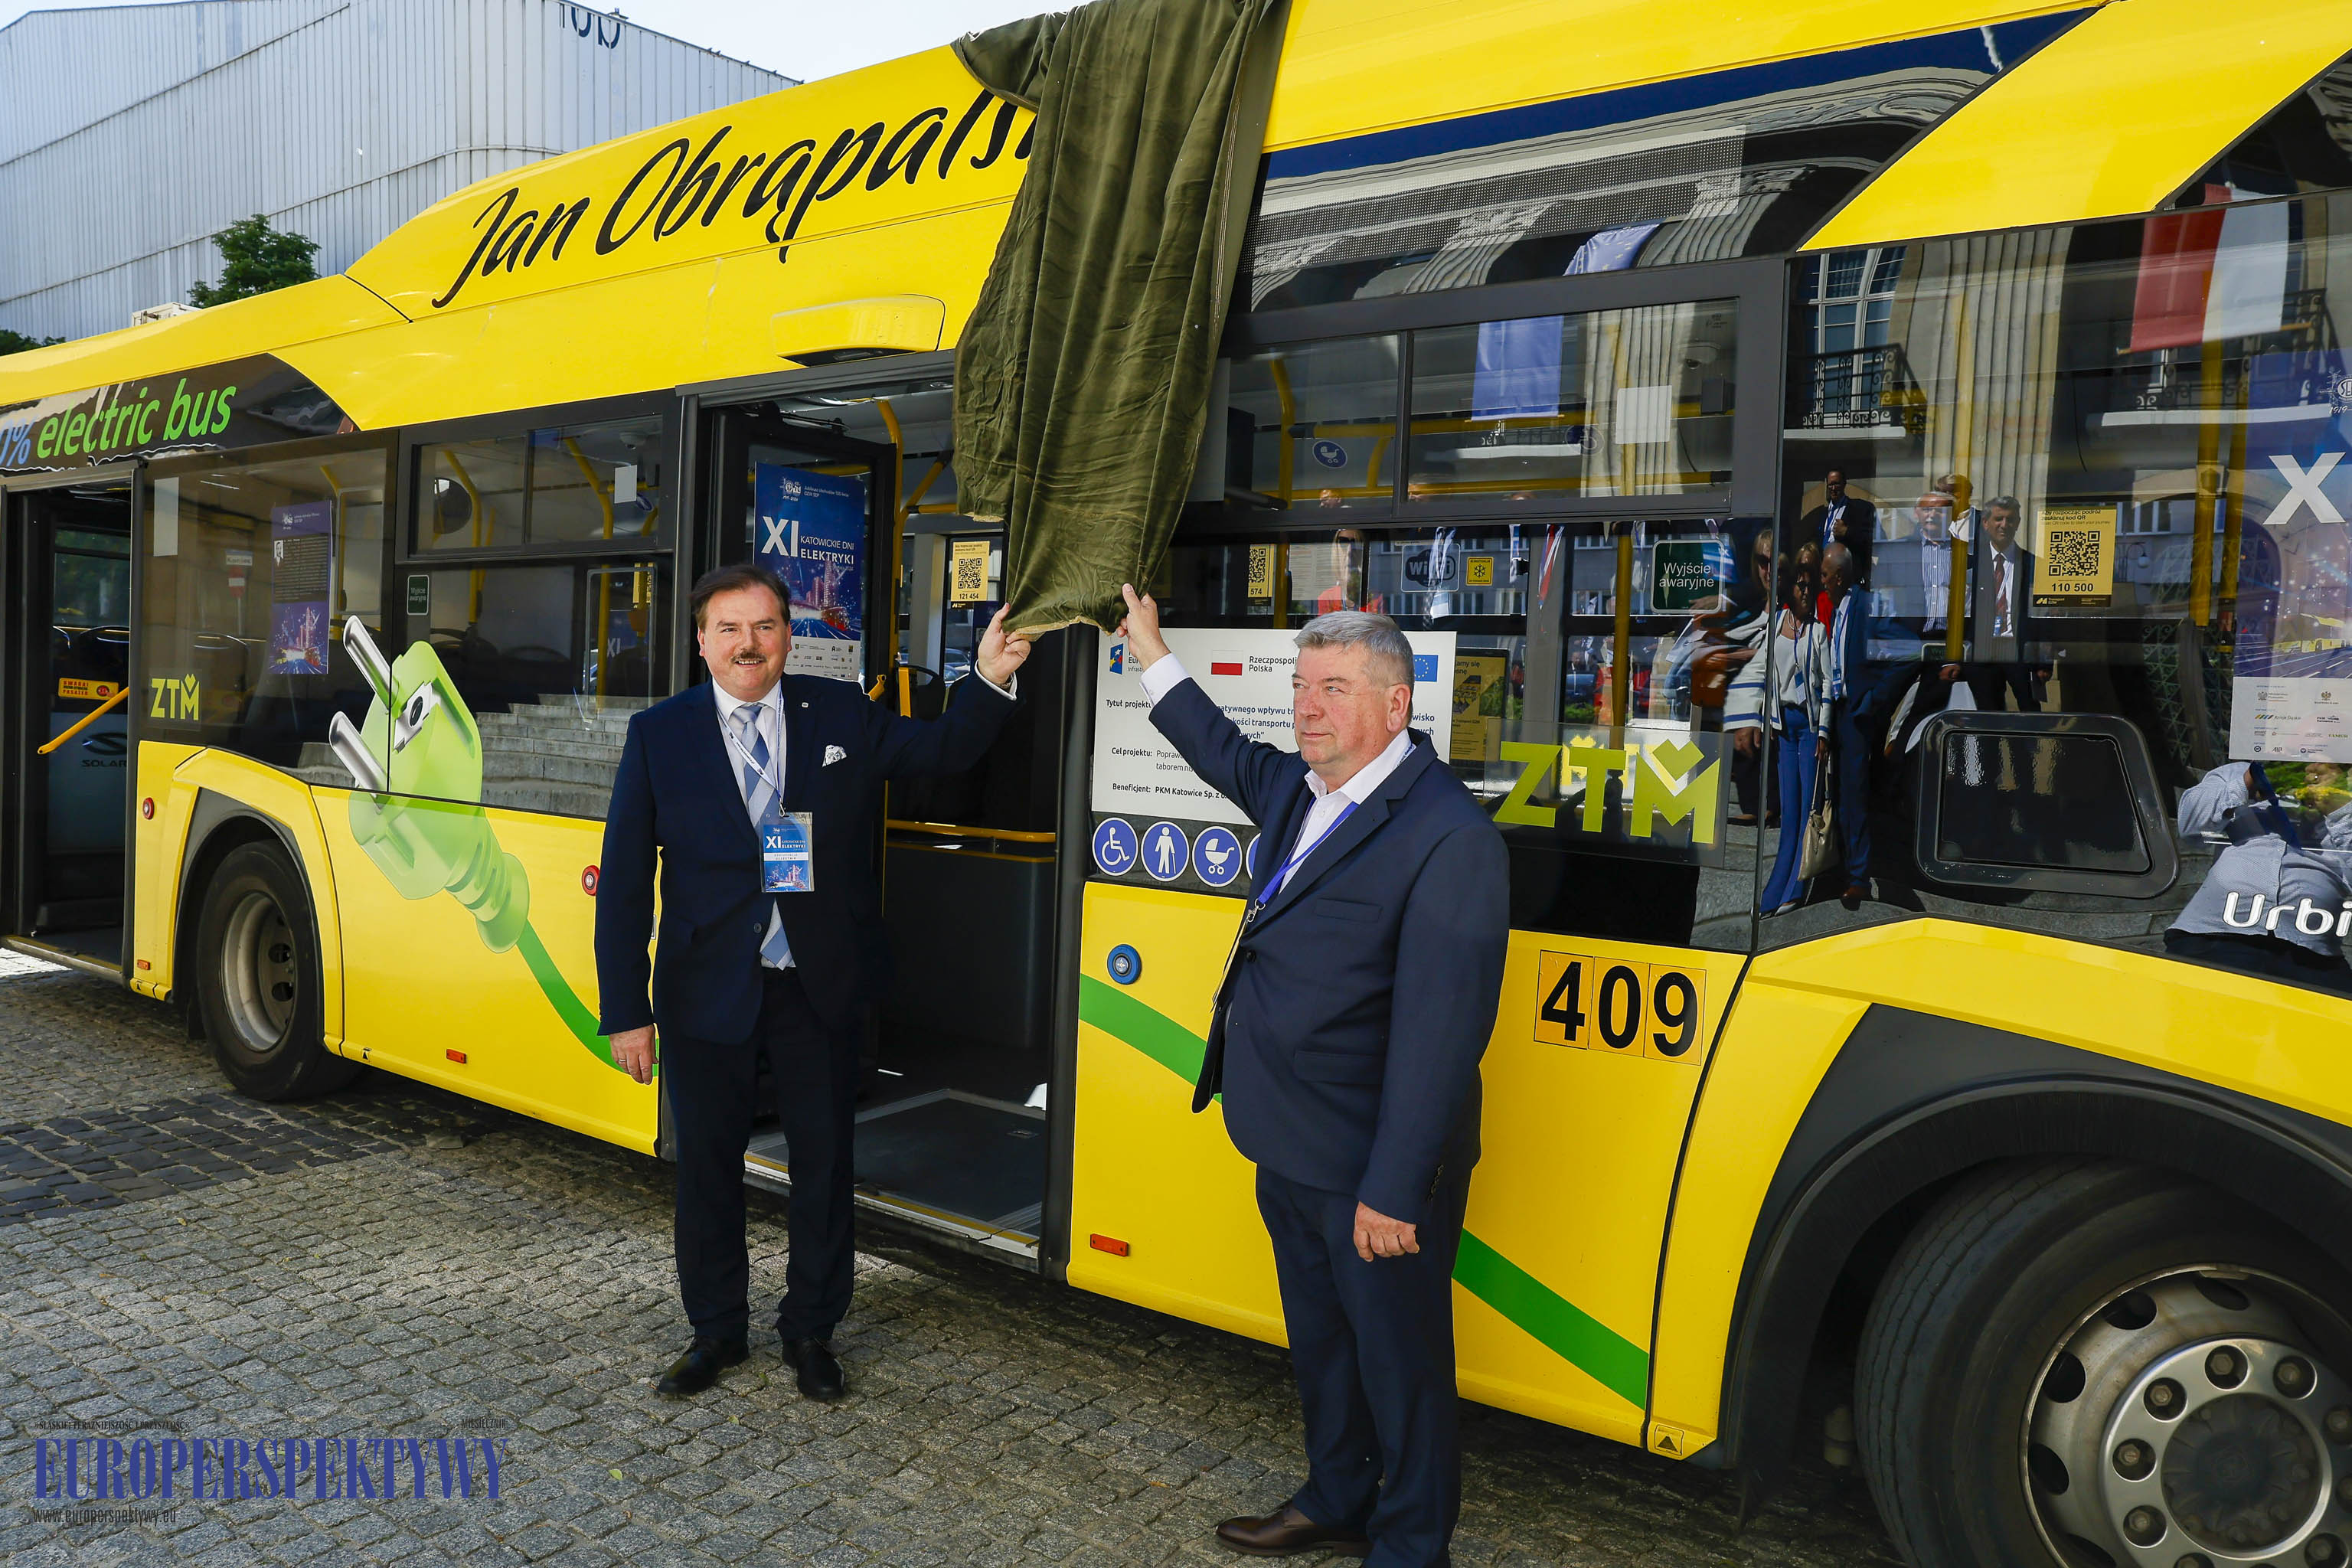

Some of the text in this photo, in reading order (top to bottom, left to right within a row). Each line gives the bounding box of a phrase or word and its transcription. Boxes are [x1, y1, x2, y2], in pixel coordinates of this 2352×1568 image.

[431, 188, 590, 308] Jan
[38, 387, 160, 459] electric
[163, 377, 237, 441] bus
[761, 516, 799, 557] XI
[800, 536, 854, 550] KATOWICKIE DNI
[800, 548, 854, 564] ELEKTRYKI
[1664, 562, 1711, 577] Wyjście
[1659, 577, 1714, 590] awaryjne
[2052, 583, 2094, 592] 110 500
[1249, 664, 1272, 672] Polska
[151, 674, 200, 720] ZTM
[1106, 699, 1122, 708] Tytuł
[1257, 706, 1285, 716] wpływu
[1252, 718, 1291, 728] transportu
[1122, 748, 1152, 757] projektu:
[1156, 763, 1184, 771] taborem
[1112, 783, 1151, 793] Beneficjent:
[1155, 786, 1171, 795] PKM
[1171, 788, 1203, 797] Katowice
[1204, 790, 1214, 799] Sp.
[1493, 738, 1720, 844] ZTM
[766, 835, 782, 848] XI
[2223, 891, 2352, 937] Urbi
[1540, 961, 1698, 1057] 409
